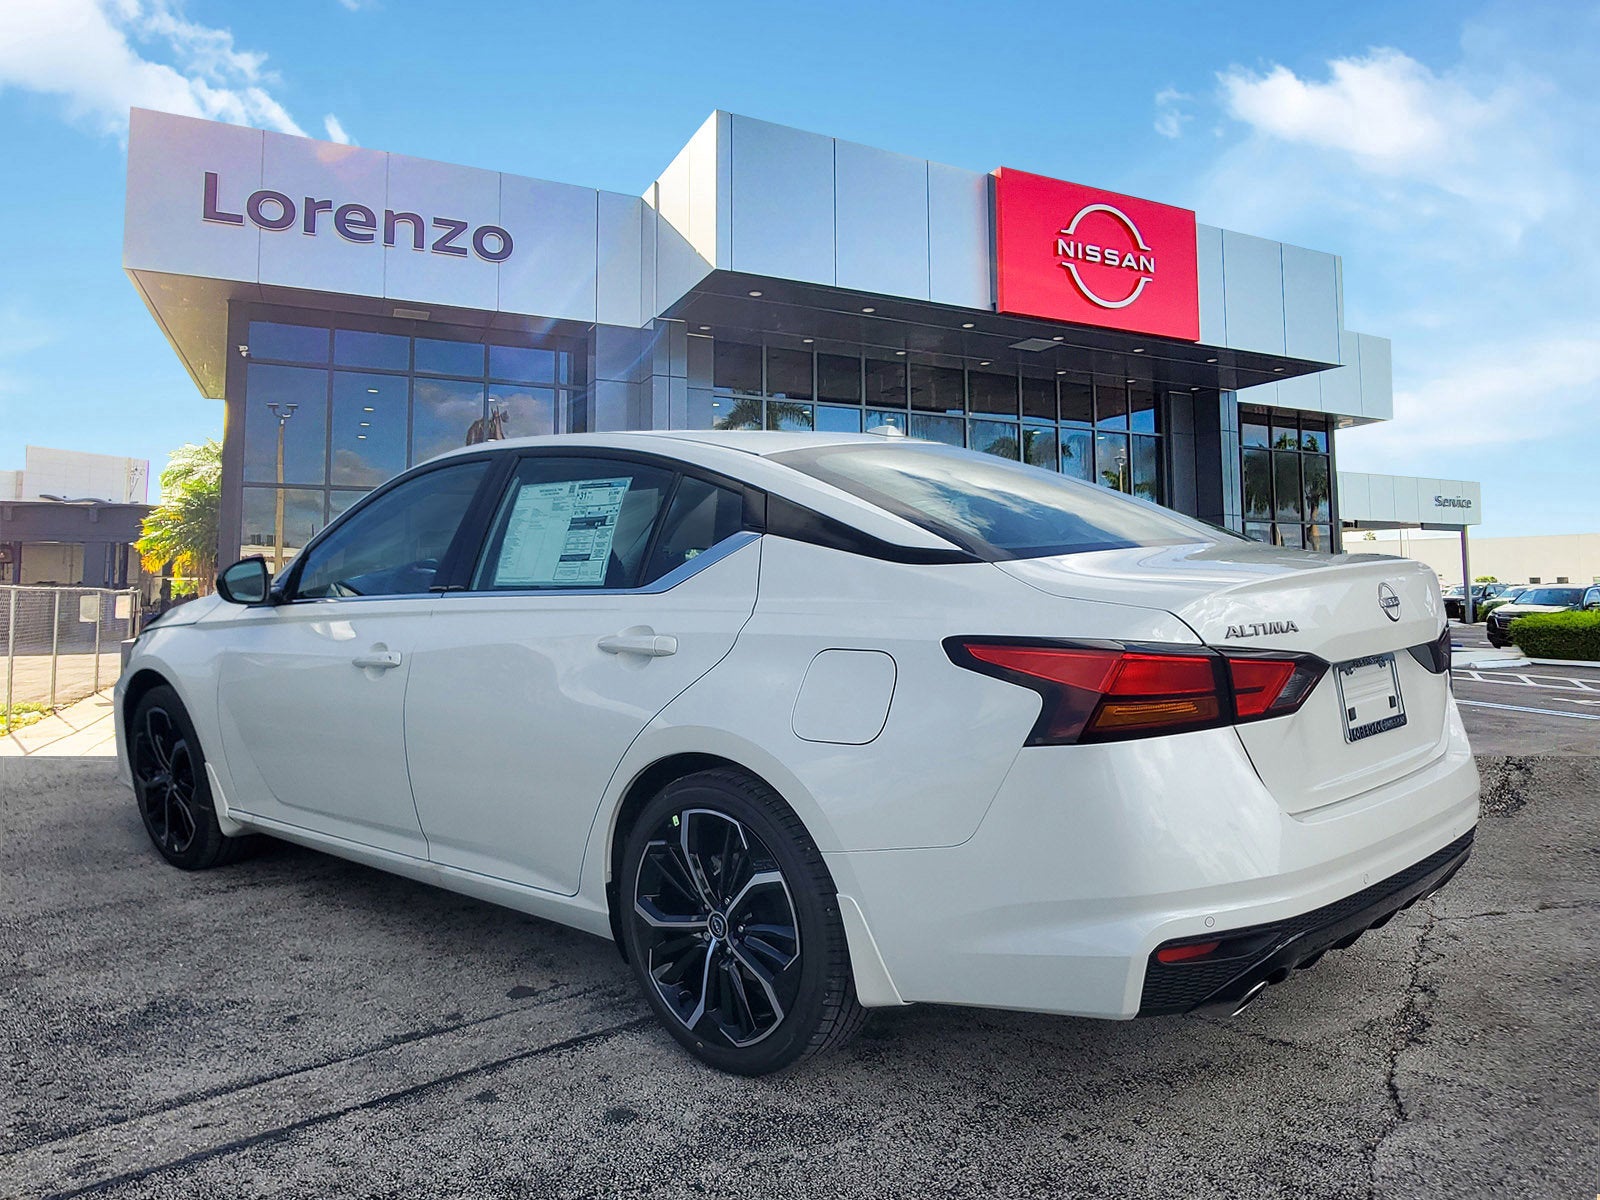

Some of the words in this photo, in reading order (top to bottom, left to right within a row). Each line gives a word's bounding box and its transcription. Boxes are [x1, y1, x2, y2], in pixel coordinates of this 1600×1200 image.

[202, 171, 514, 262] Lorenzo
[1057, 238, 1155, 273] NISSAN
[1434, 495, 1472, 509] Service
[1225, 620, 1300, 639] ALTIMA
